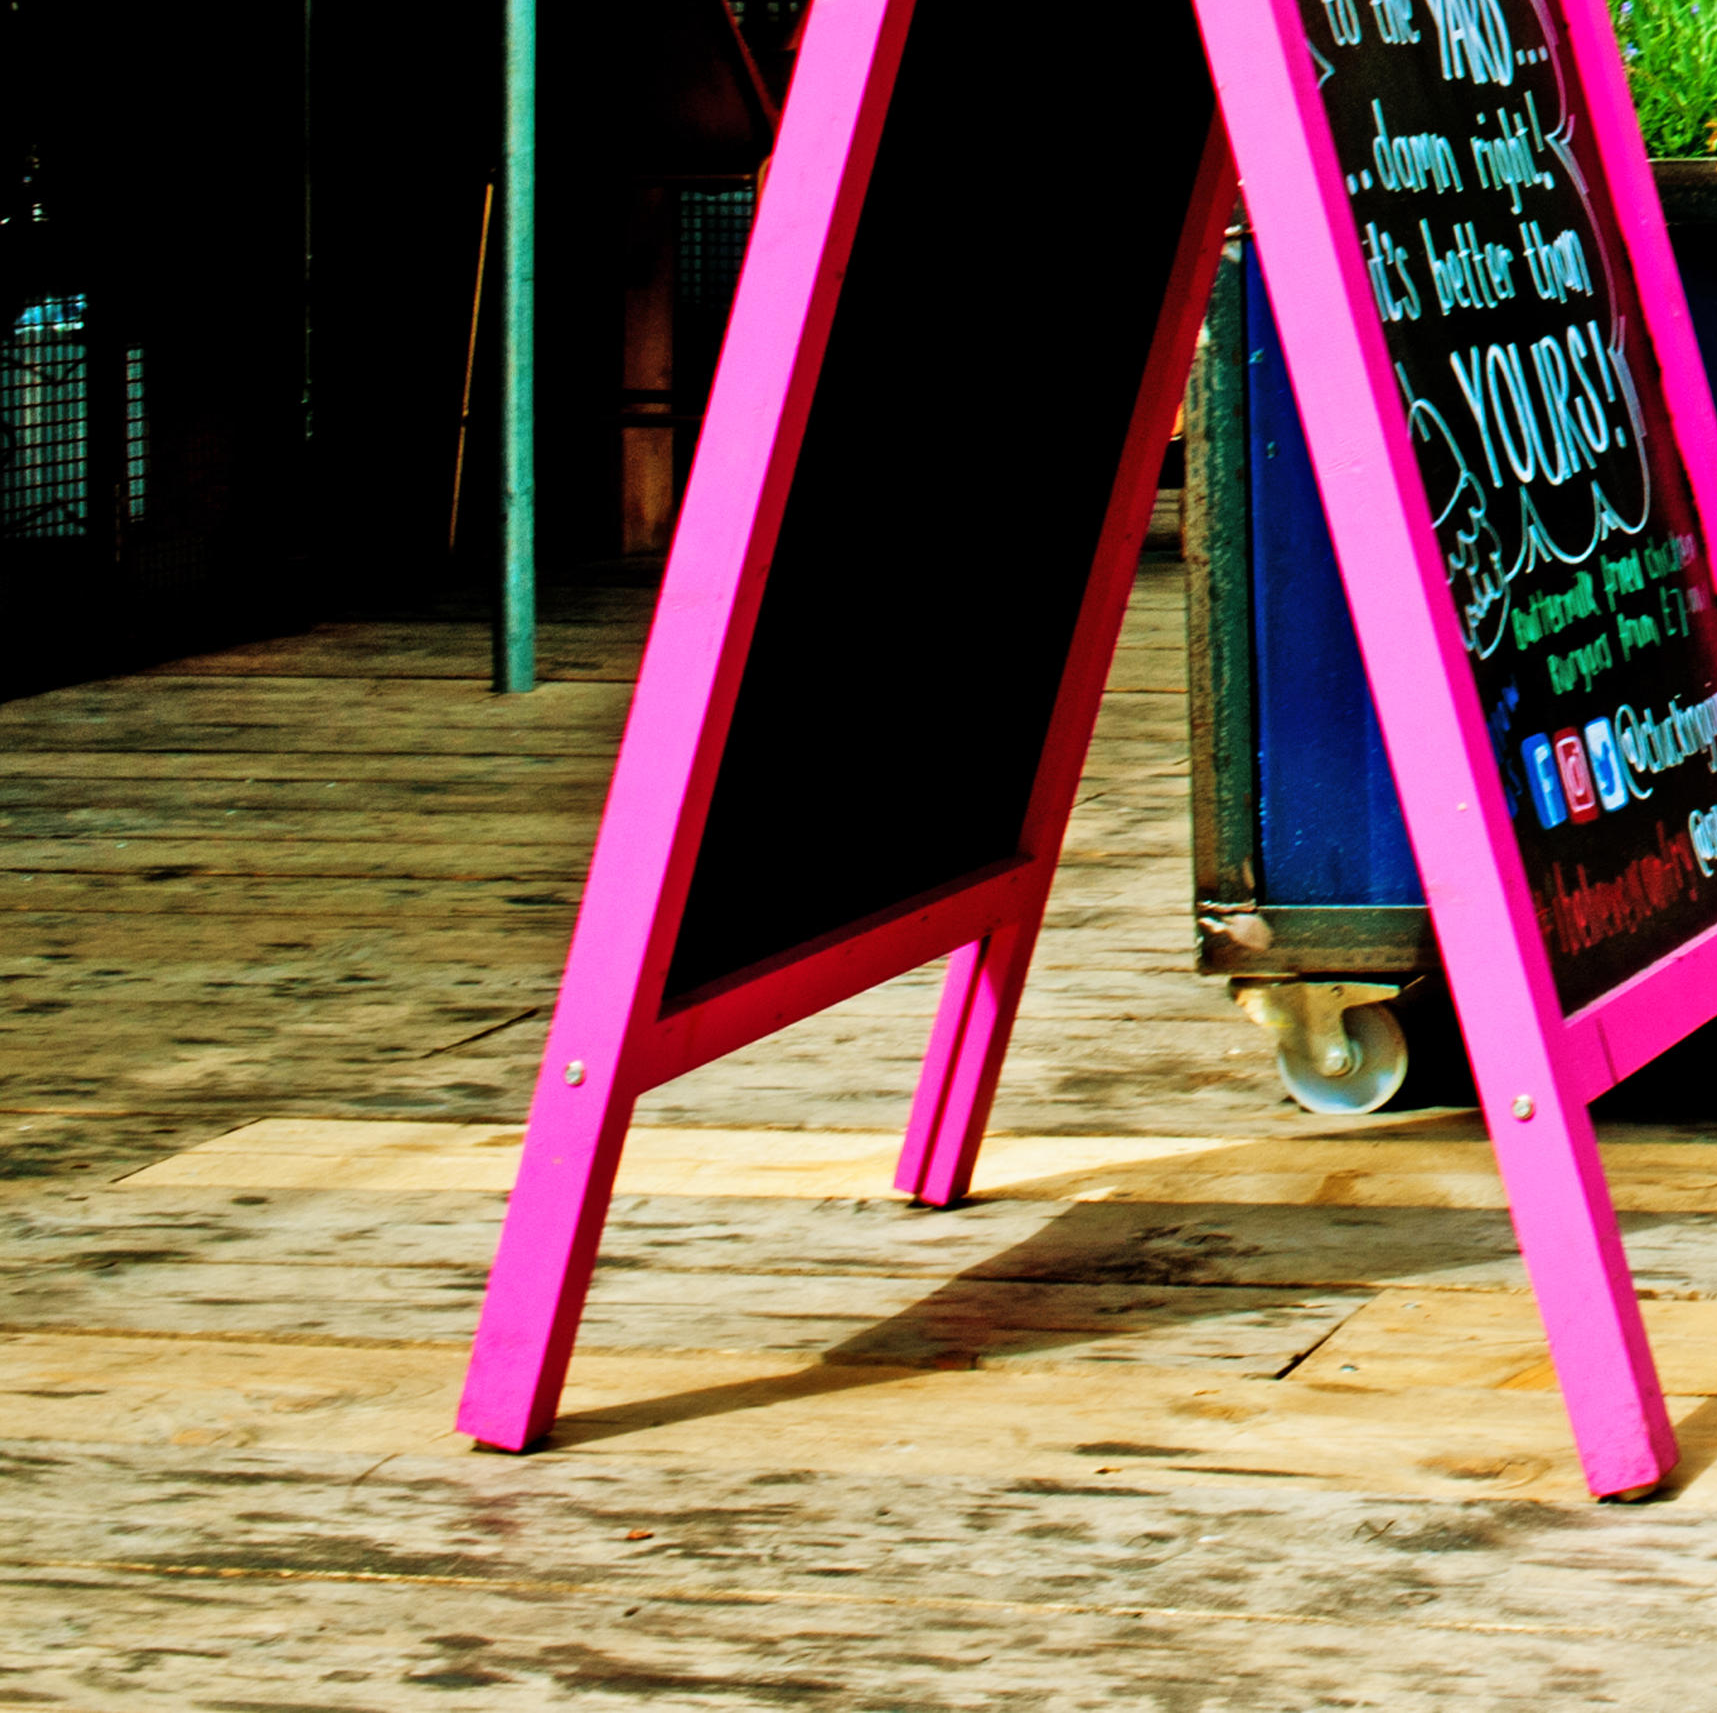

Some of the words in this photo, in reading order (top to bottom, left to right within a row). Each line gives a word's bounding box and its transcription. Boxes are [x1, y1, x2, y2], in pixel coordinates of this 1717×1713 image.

[1419, 218, 1516, 316] better
[1519, 220, 1594, 304] than
[1450, 319, 1627, 489] YOURS!
